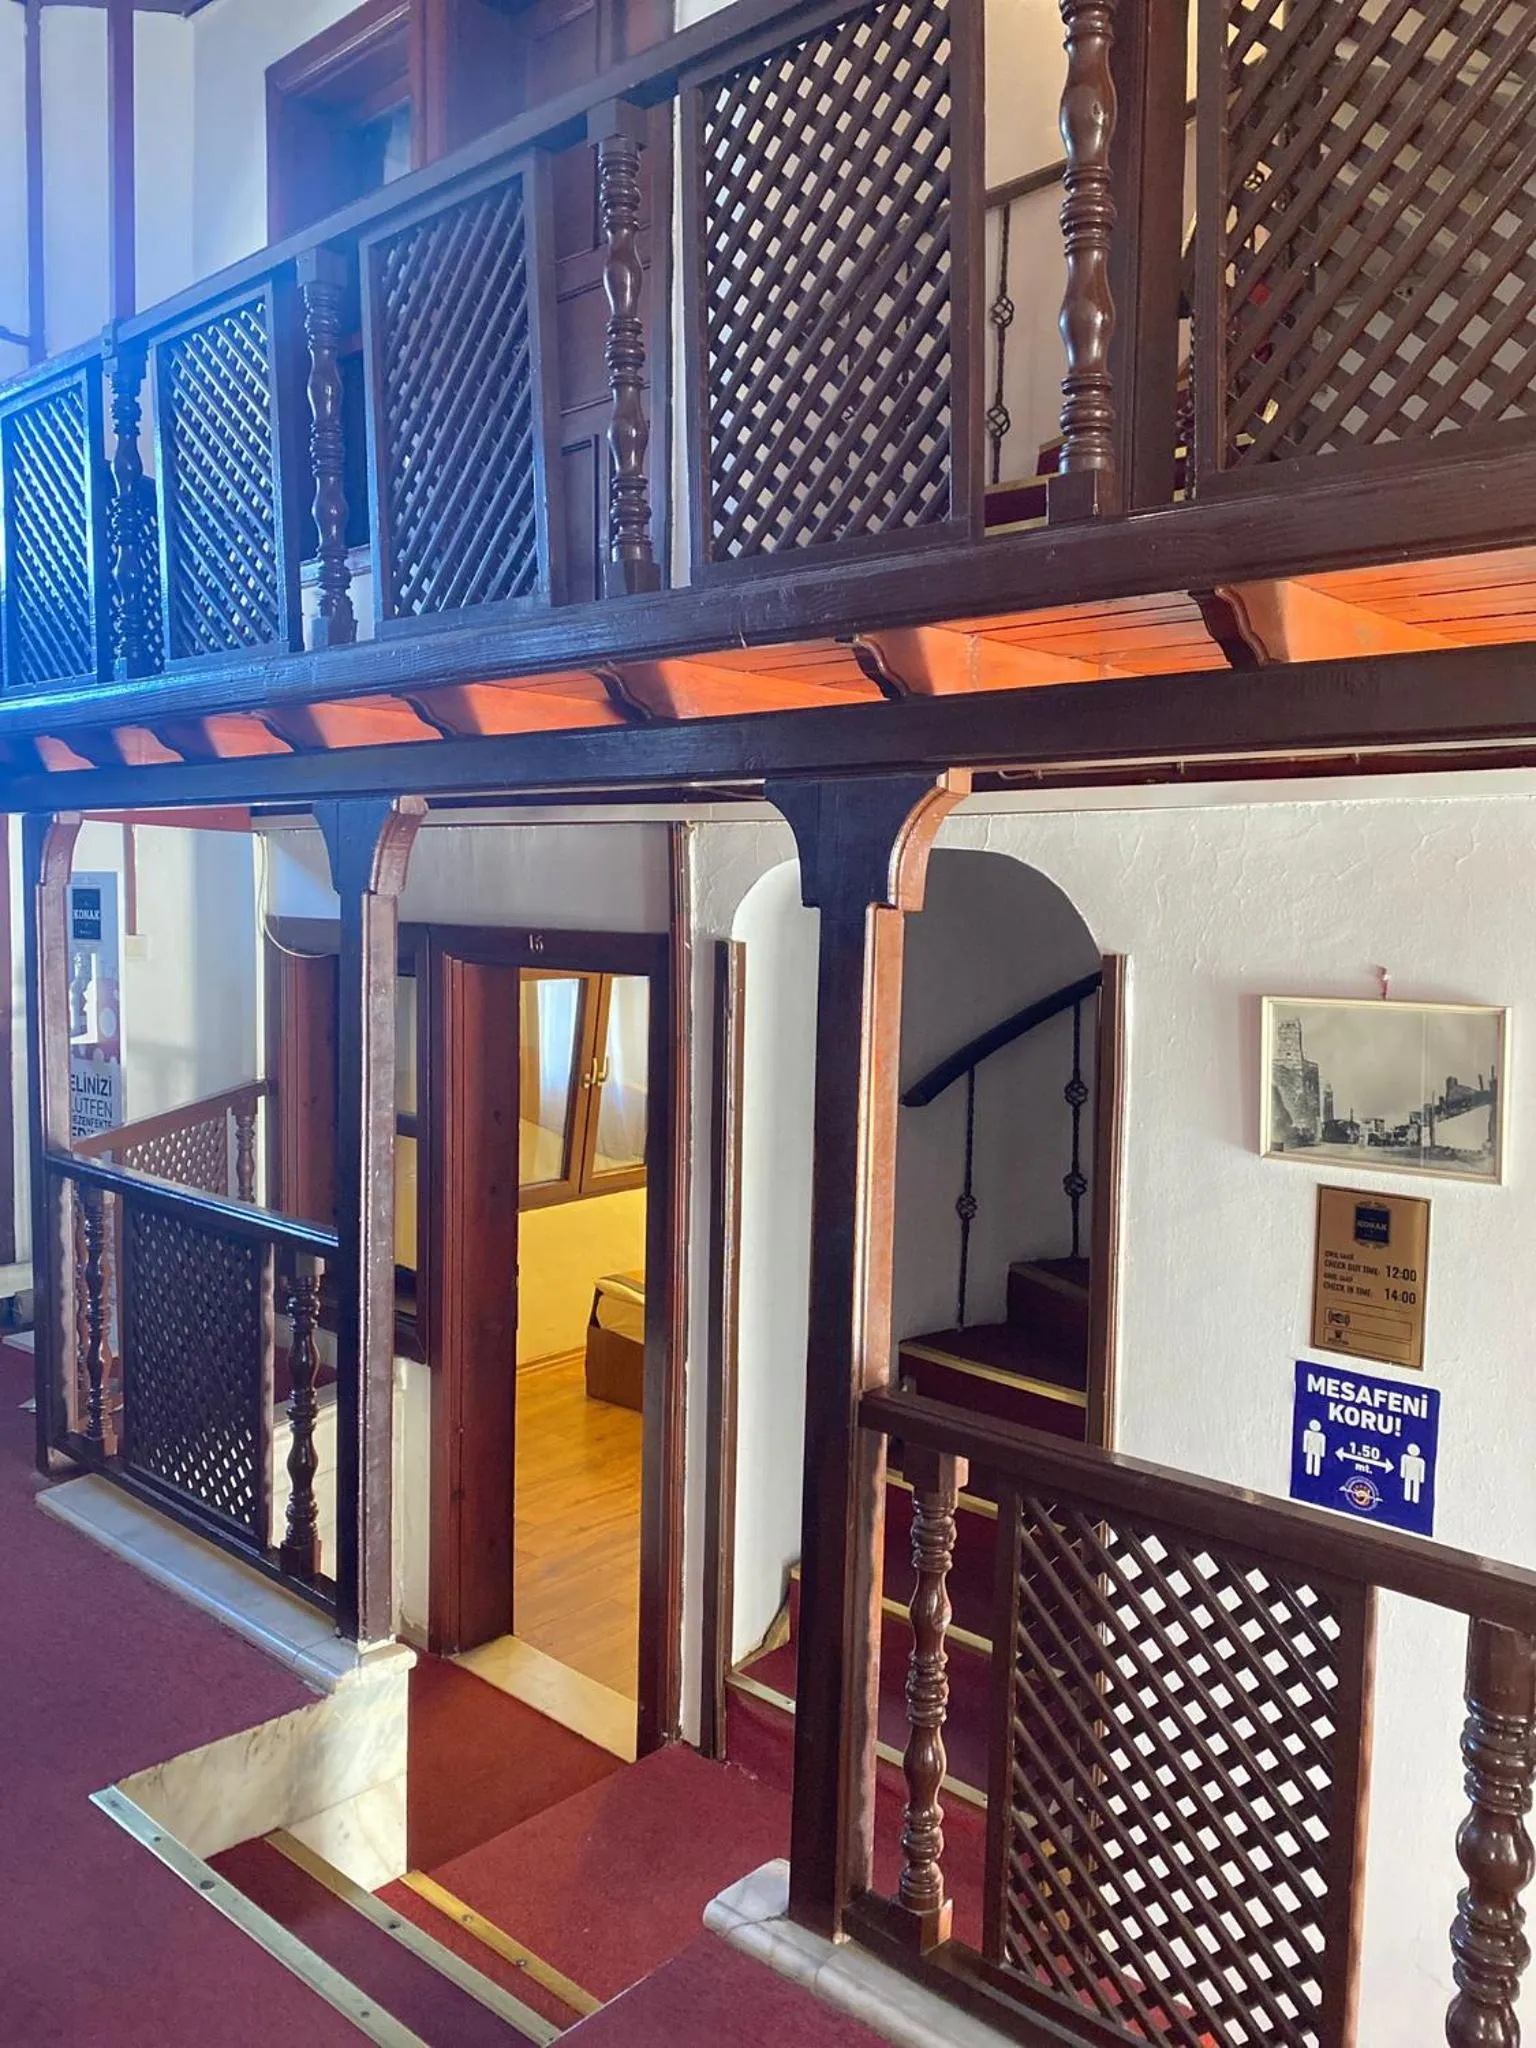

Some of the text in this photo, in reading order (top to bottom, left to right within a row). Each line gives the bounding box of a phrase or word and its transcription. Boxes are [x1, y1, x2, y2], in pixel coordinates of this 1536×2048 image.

[73, 909, 101, 920] KONAK
[1386, 1265, 1417, 1282] 12:00
[1385, 1288, 1416, 1305] 14:00
[1307, 1373, 1429, 1419] MESAFENİ
[1328, 1402, 1402, 1437] KORU!
[1350, 1441, 1380, 1460] 1.50
[1355, 1463, 1373, 1474] mt.
